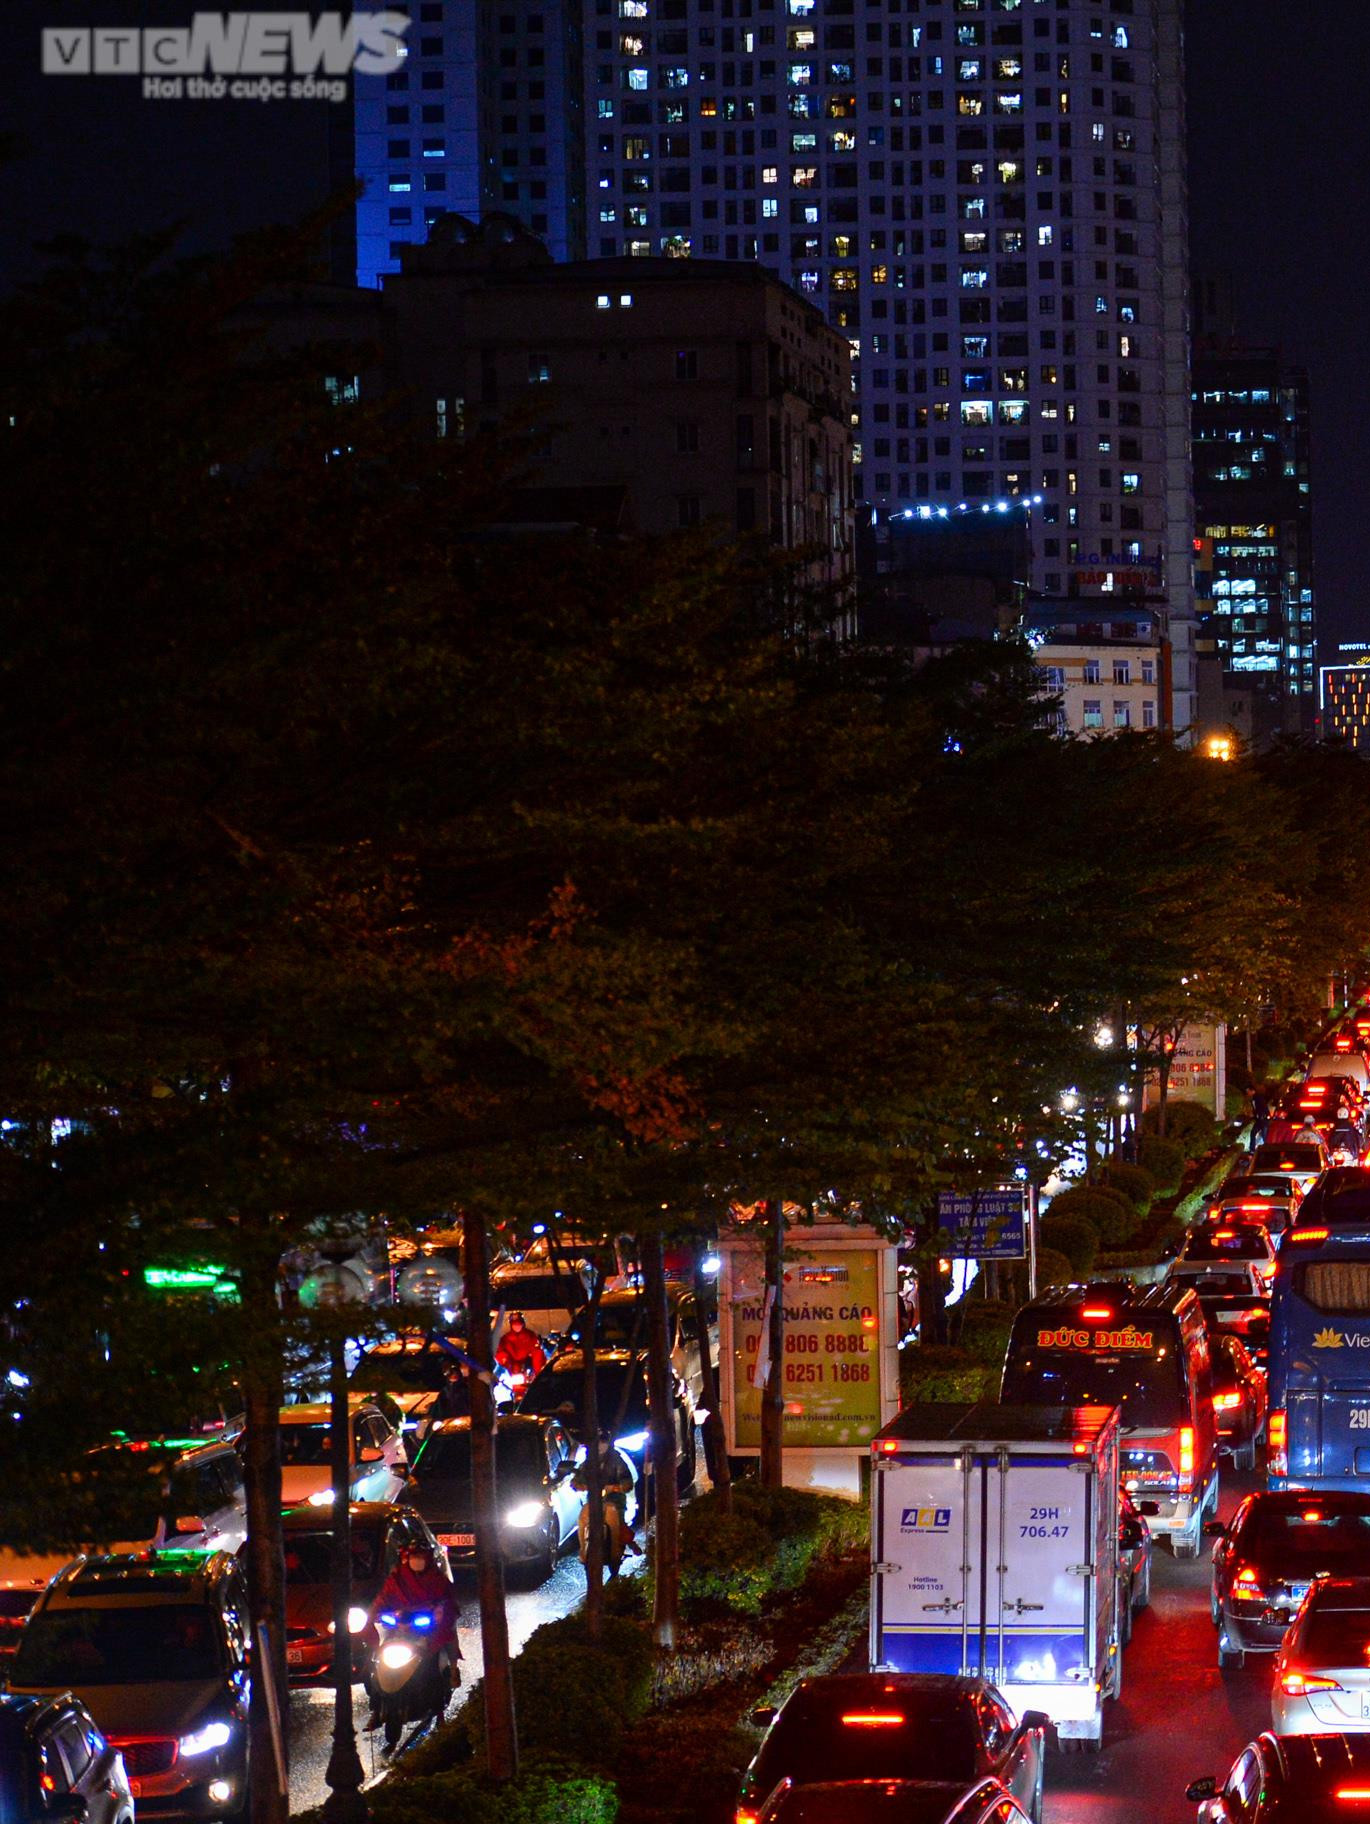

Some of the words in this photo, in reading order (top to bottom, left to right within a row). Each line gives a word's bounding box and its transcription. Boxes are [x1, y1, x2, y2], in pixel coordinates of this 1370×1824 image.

[1338, 643, 1367, 651] NOVOTEL
[786, 1334, 818, 1353] 806
[1038, 1326, 1090, 1347] ĐỨC
[1094, 1324, 1153, 1348] ĐIỂM
[786, 1363, 824, 1382] 6251
[831, 1363, 870, 1382] 1868
[1030, 1507, 1059, 1519] 29H
[1019, 1526, 1069, 1538] 706.47
